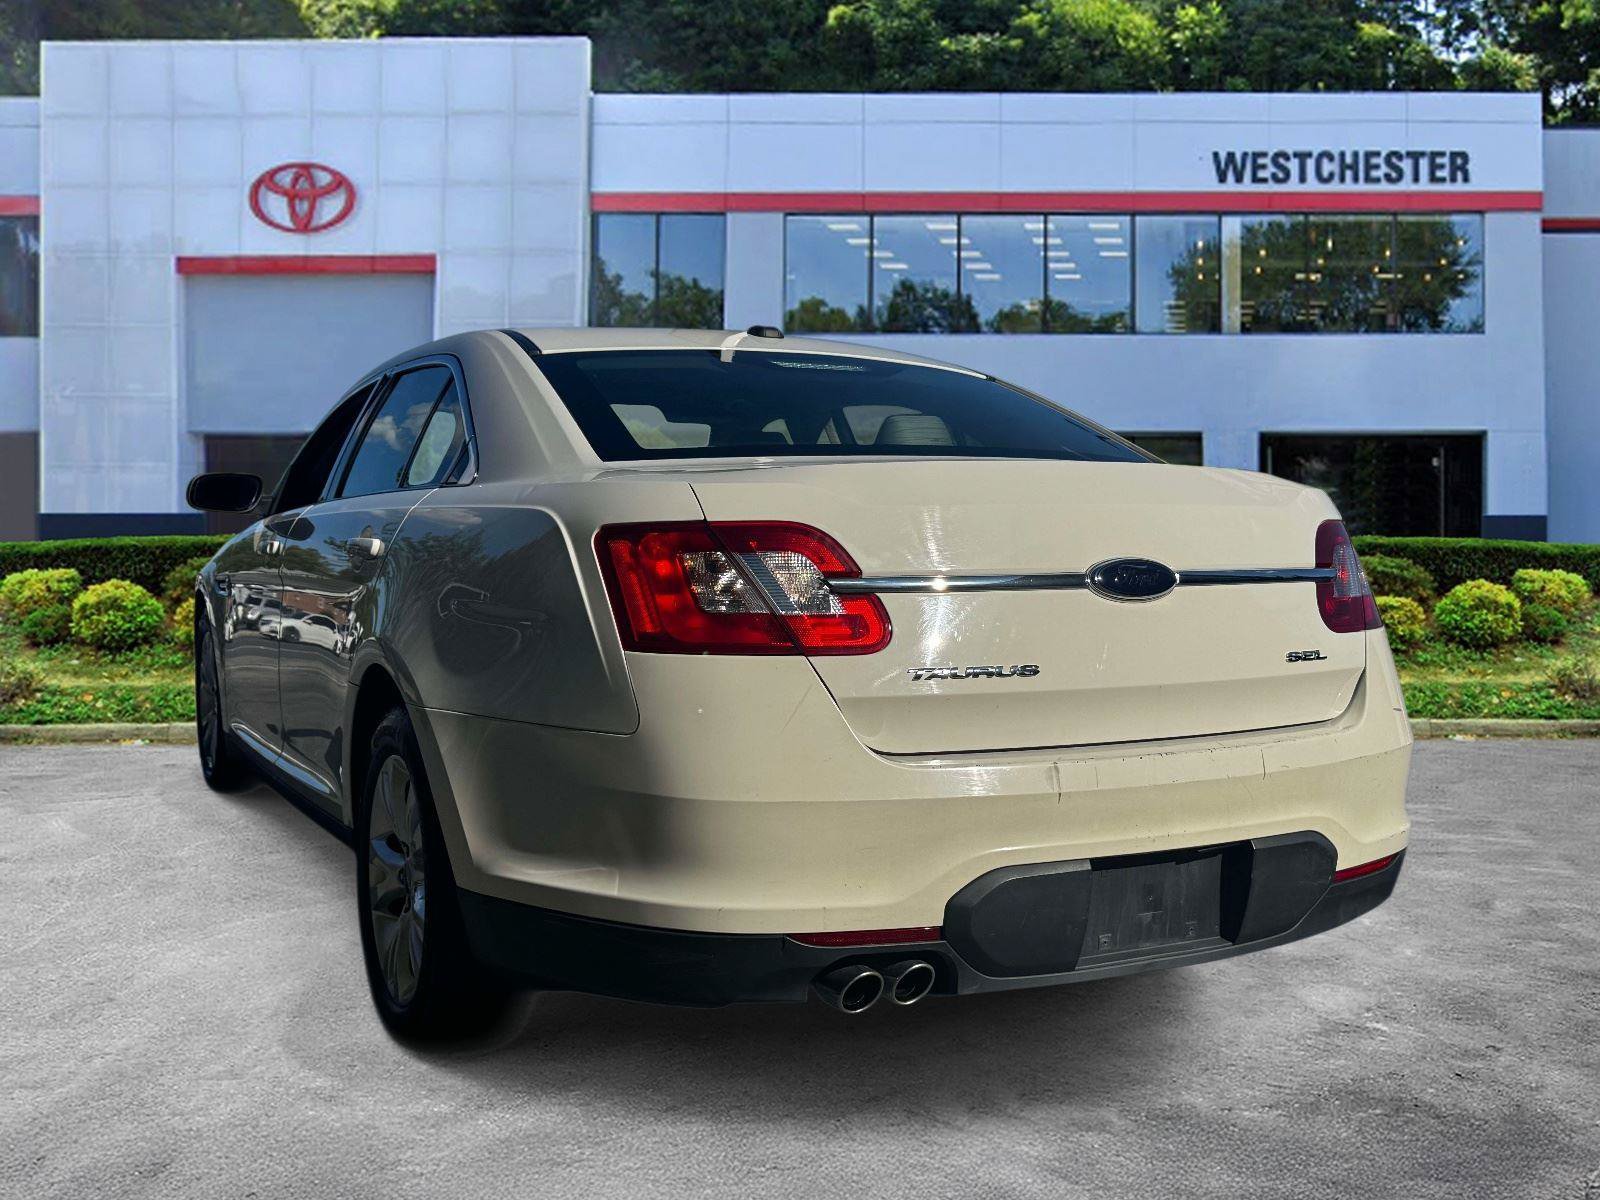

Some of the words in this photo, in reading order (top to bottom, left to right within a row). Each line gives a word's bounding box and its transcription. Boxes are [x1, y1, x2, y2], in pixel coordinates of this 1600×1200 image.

[1212, 150, 1470, 184] WESTCHESTER
[1285, 650, 1328, 662] SEL
[907, 664, 1041, 681] TAURUS
